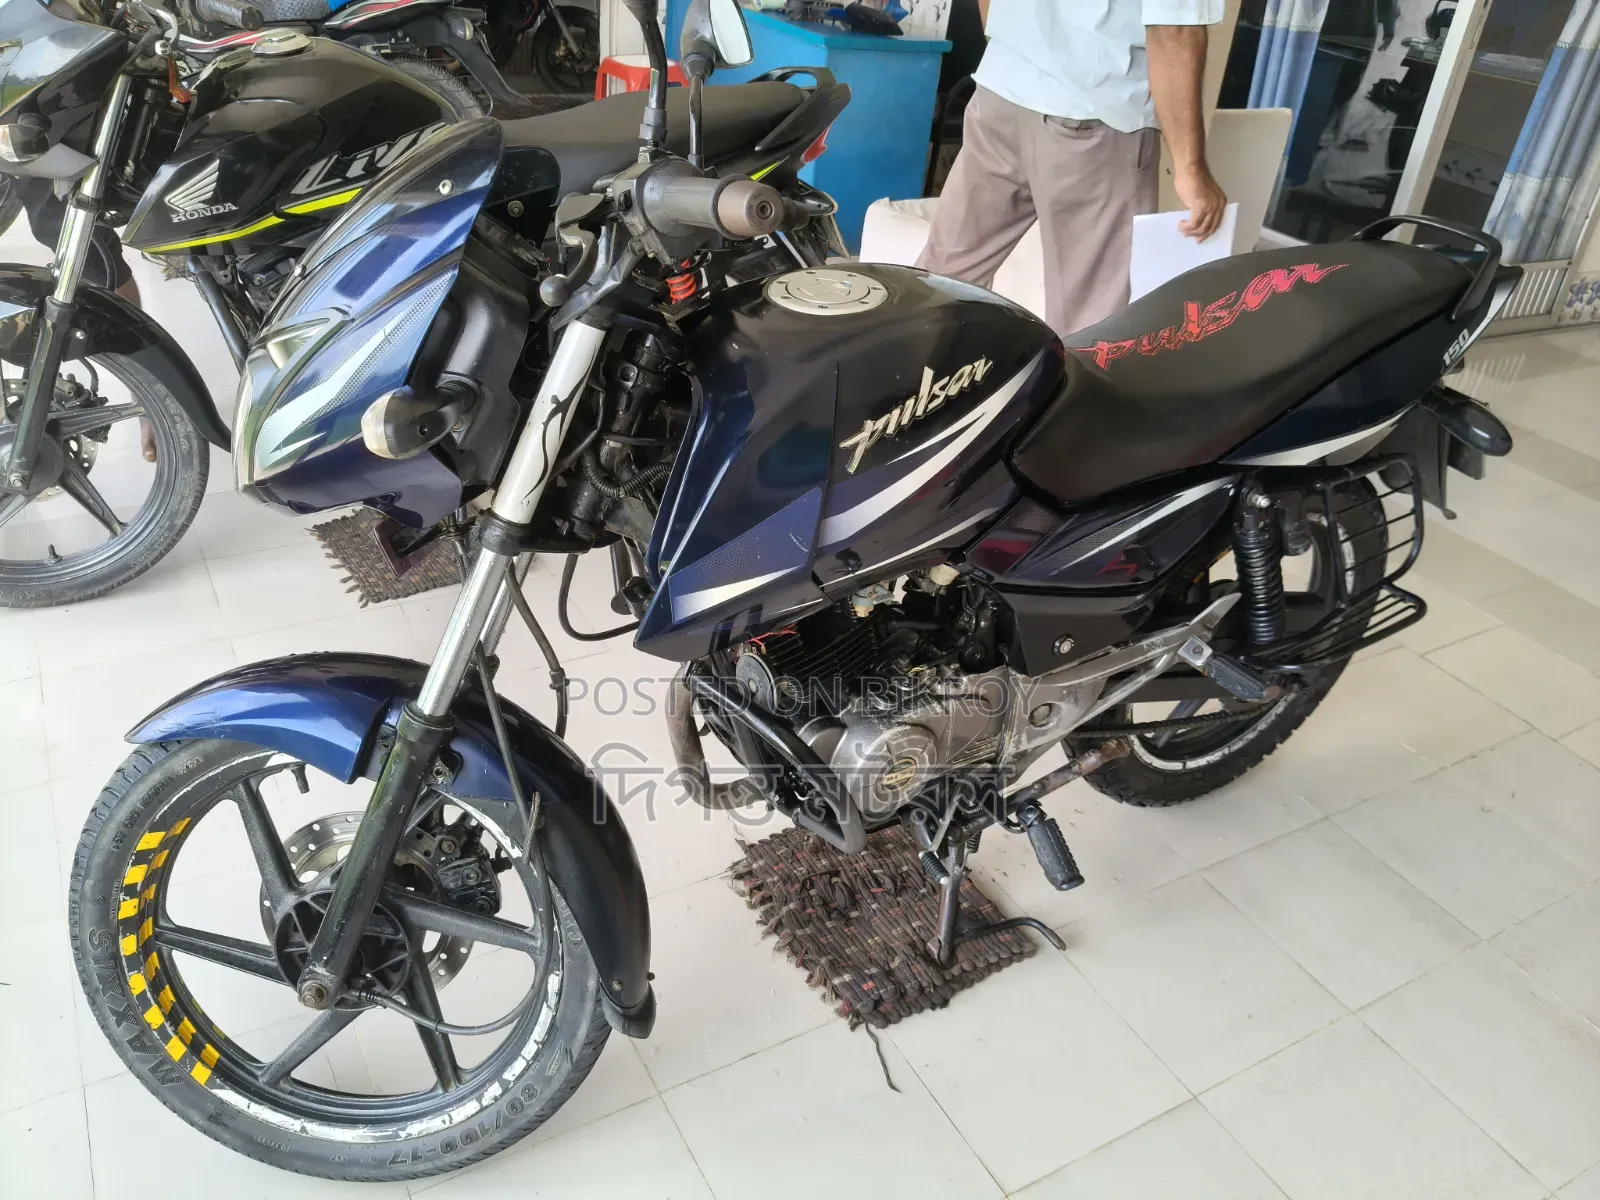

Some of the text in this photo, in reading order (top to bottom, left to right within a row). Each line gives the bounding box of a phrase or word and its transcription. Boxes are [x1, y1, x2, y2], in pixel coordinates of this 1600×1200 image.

[171, 202, 240, 223] HONDA
[1443, 328, 1470, 366] 150
[88, 926, 186, 1087] MAXXIS
[387, 1082, 540, 1167] 80/100-17
